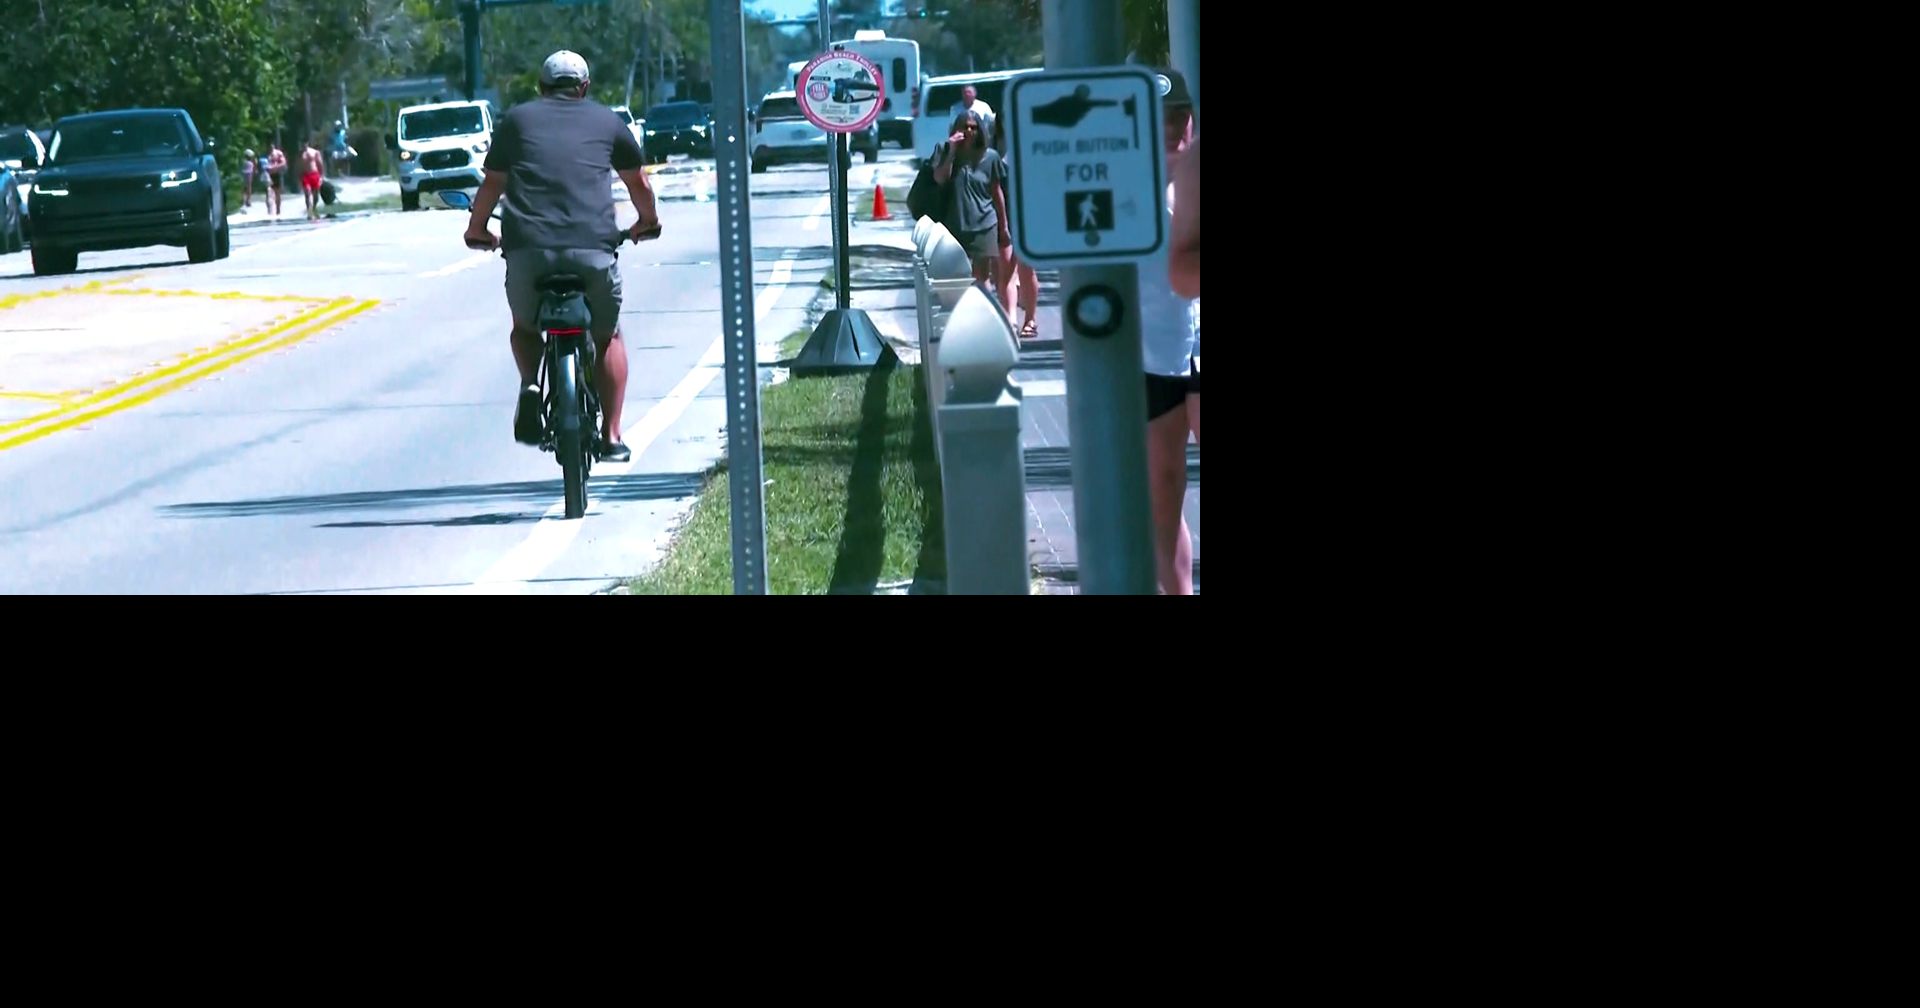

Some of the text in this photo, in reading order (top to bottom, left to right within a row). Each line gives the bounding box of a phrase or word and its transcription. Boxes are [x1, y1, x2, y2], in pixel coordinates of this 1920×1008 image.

[1031, 137, 1129, 156] PUSH BUTTON
[1065, 163, 1108, 182] FOR
